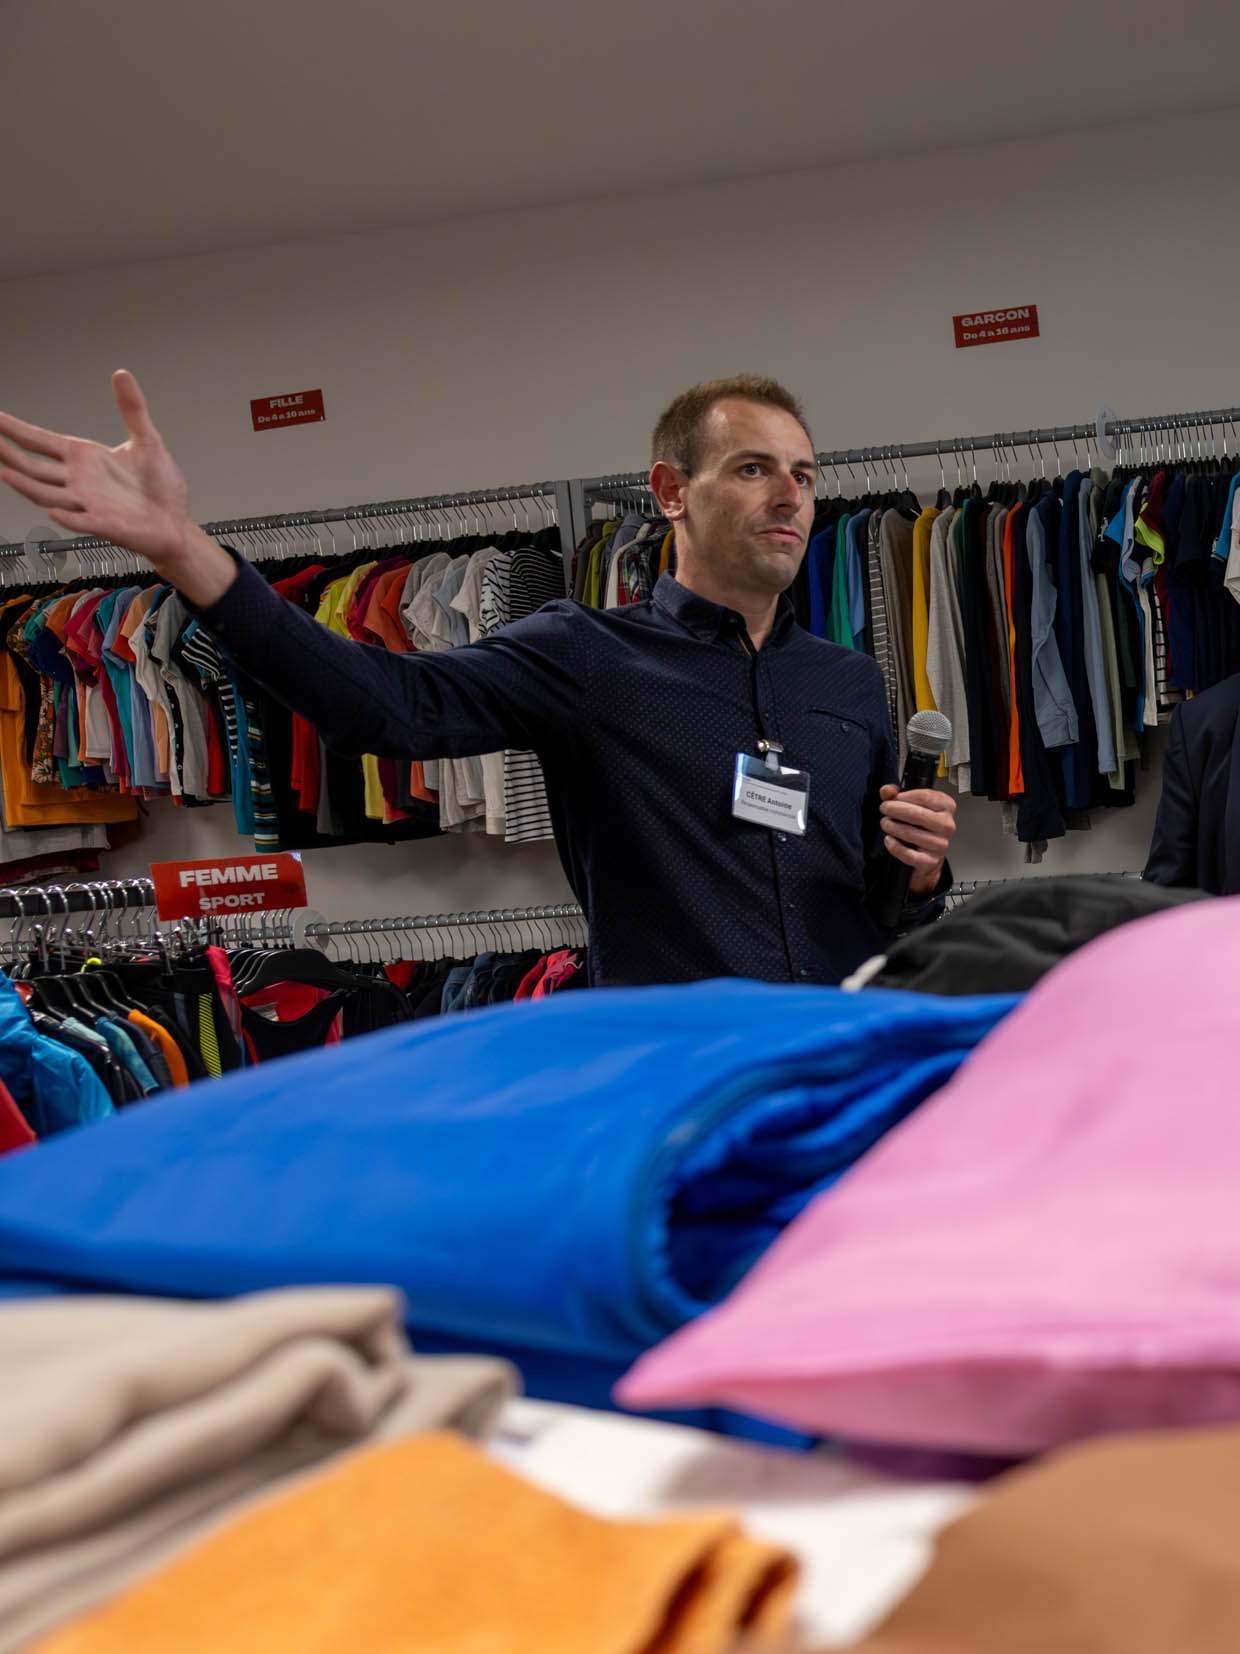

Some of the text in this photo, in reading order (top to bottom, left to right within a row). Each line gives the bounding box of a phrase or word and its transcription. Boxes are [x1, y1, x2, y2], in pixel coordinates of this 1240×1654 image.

[962, 332, 978, 341] De
[978, 330, 987, 338] 4
[1010, 325, 1031, 334] ans
[269, 395, 304, 409] FILLE
[767, 797, 793, 810] Antoine
[179, 863, 279, 888] FEMME
[199, 892, 266, 910] SPORT
